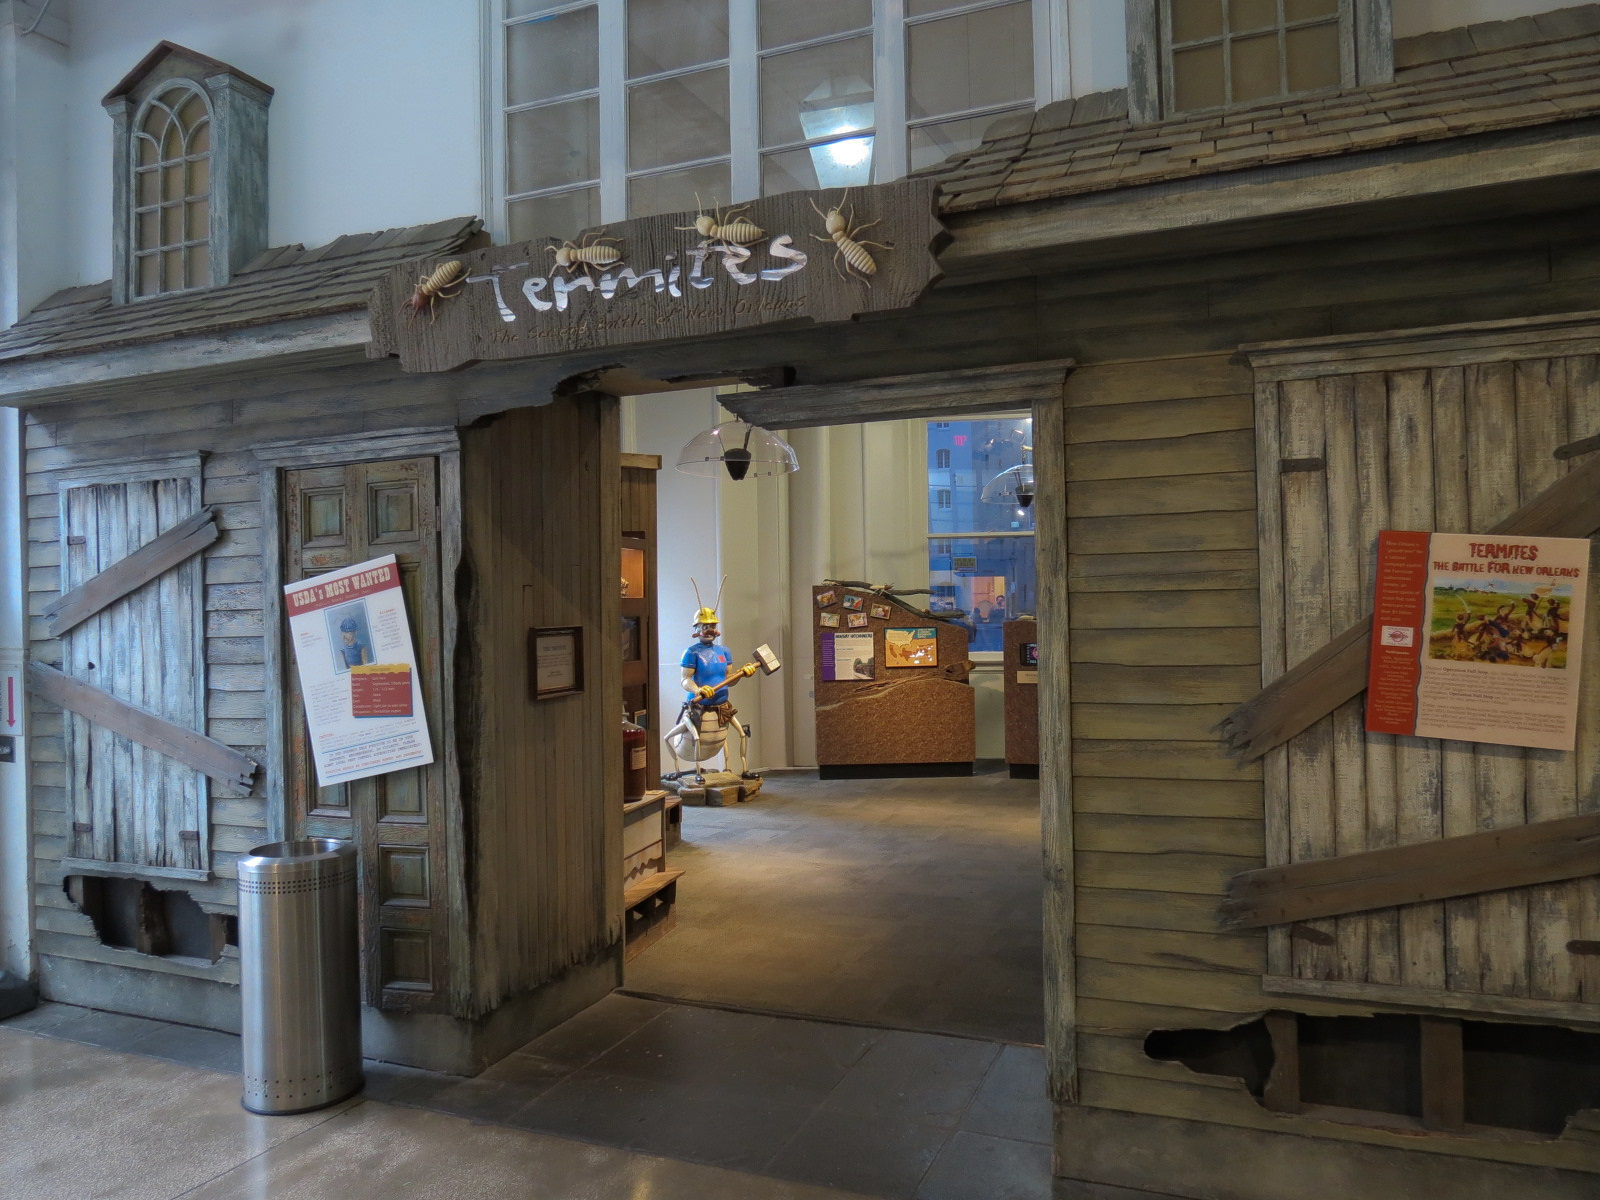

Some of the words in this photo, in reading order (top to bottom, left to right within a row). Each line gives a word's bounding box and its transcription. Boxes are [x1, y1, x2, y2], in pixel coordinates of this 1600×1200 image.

[465, 234, 807, 322] Termites
[491, 329, 519, 344] The
[526, 321, 588, 340] Second
[596, 312, 646, 332] Battle
[655, 306, 682, 325] of
[685, 303, 724, 320] New
[733, 295, 807, 315] Orleans
[1432, 561, 1450, 571] THE
[1452, 561, 1485, 573] BATTLE
[1487, 560, 1511, 574] FOR
[1512, 564, 1534, 575] NEW
[1535, 566, 1580, 578] ORLEANS
[1468, 542, 1539, 561] TERMITES
[292, 587, 324, 608] USDA's
[324, 578, 351, 599] MOST
[351, 566, 391, 590] WANTED
